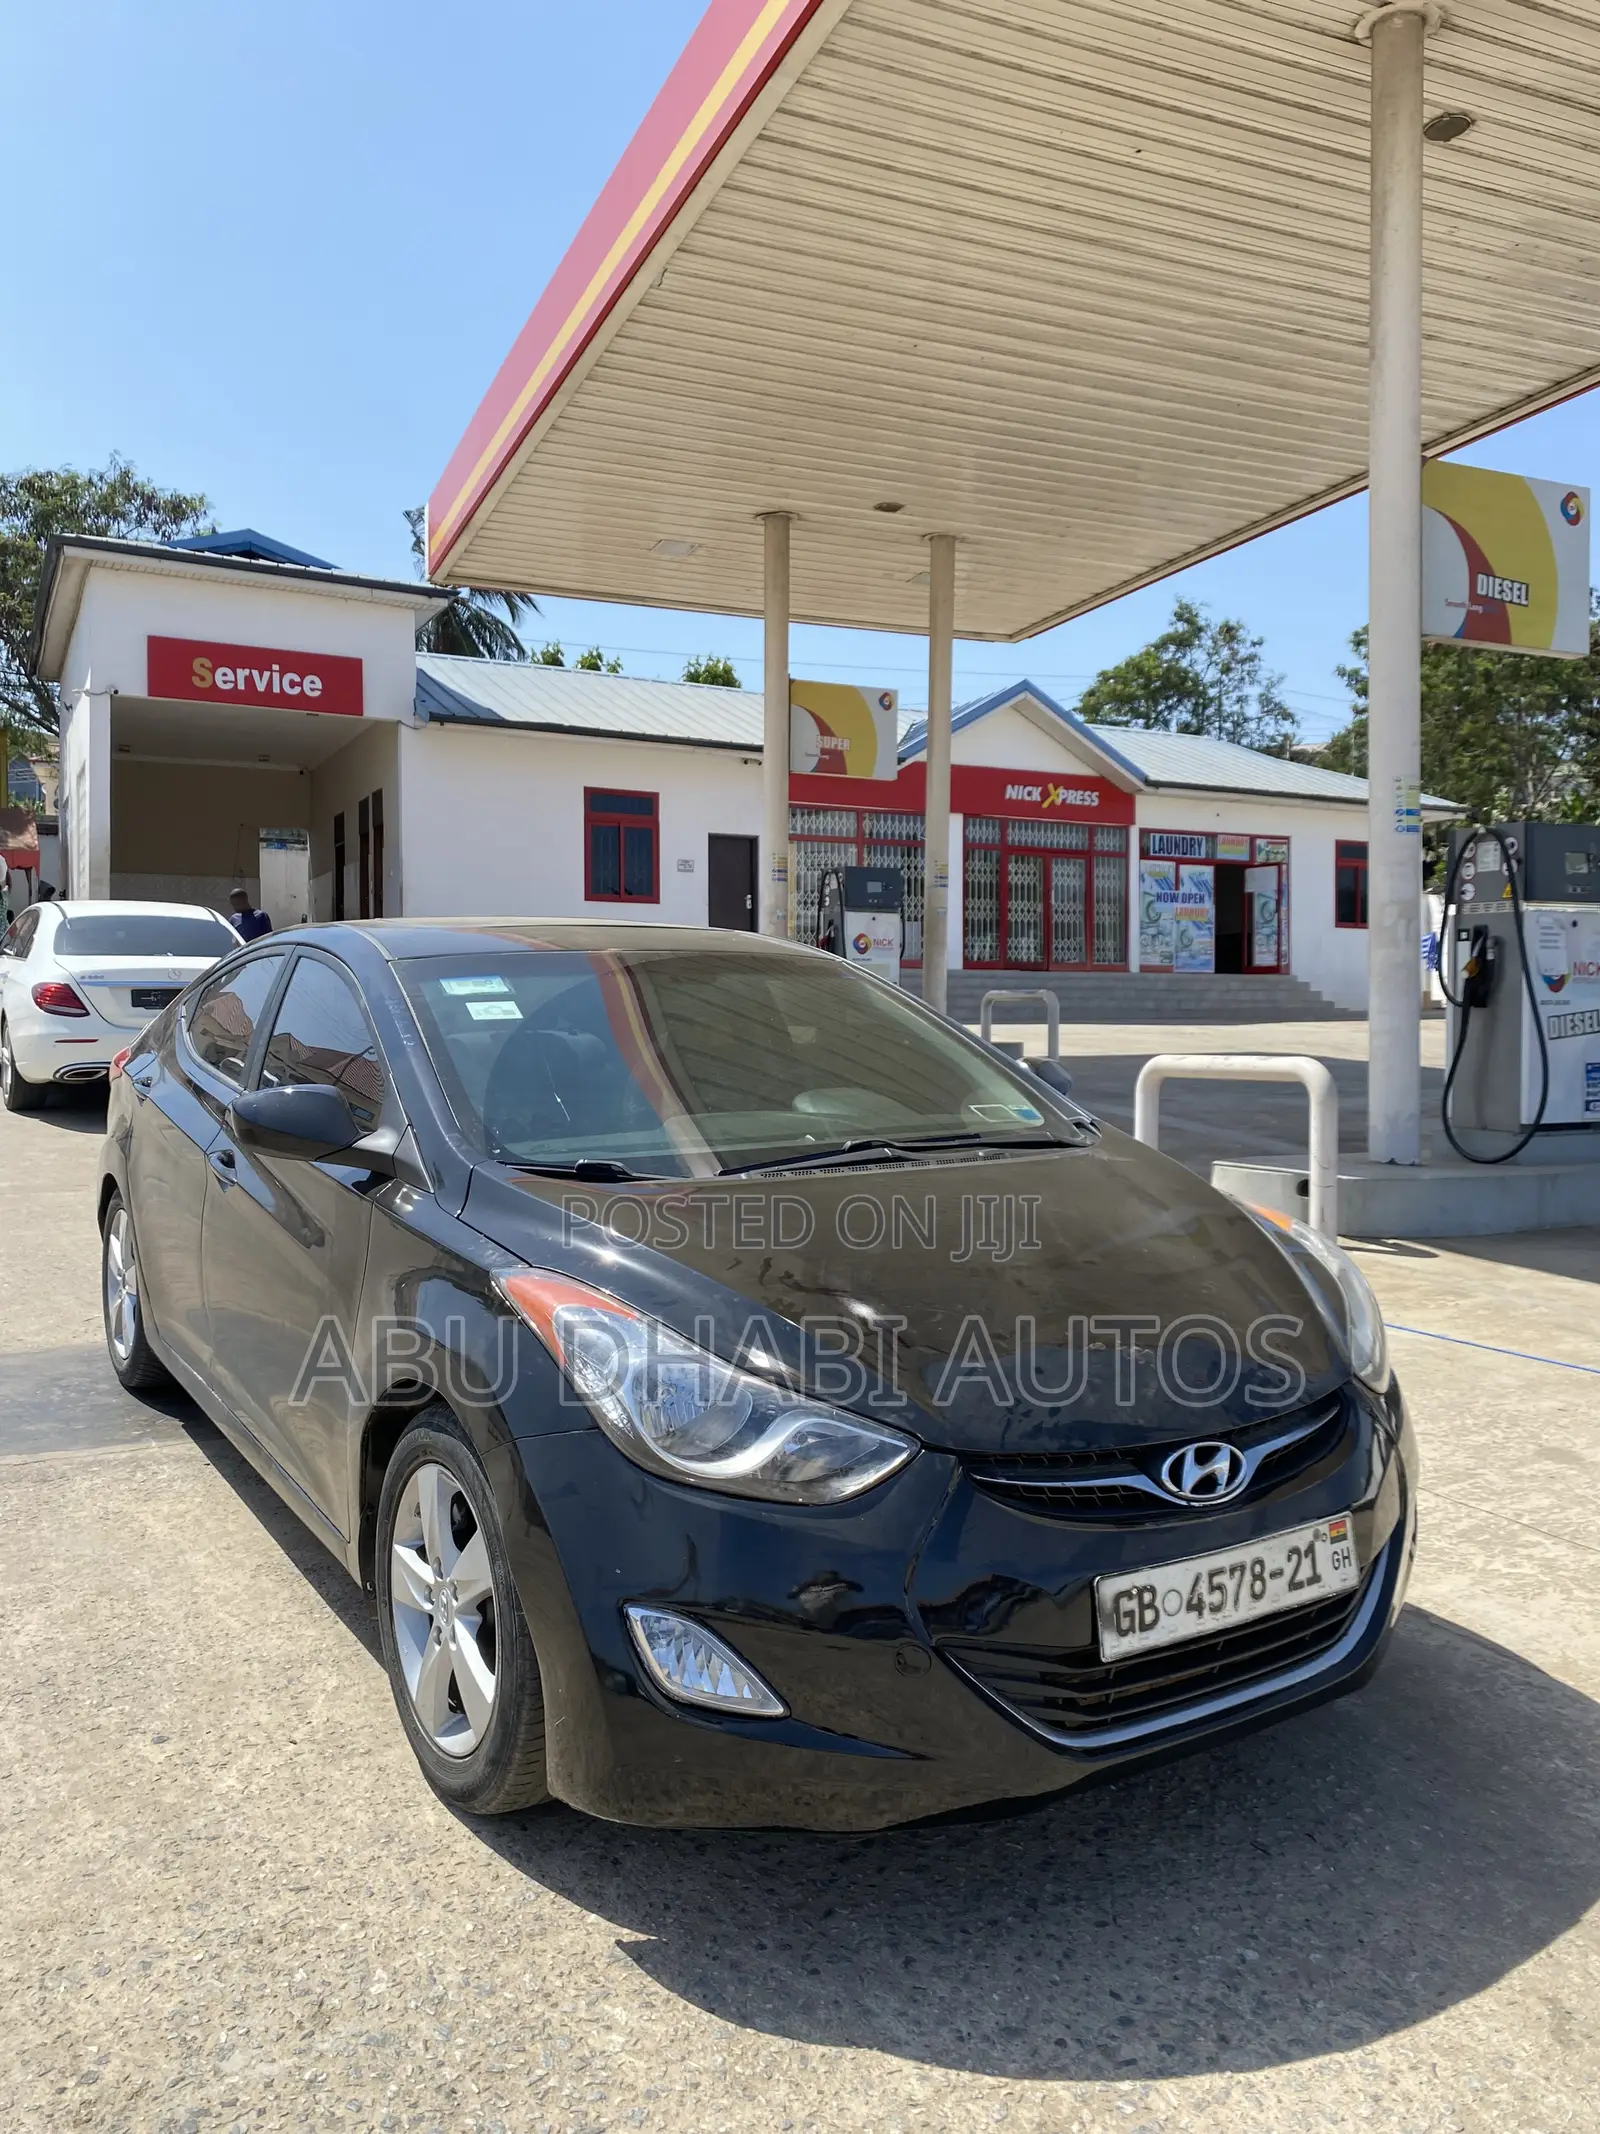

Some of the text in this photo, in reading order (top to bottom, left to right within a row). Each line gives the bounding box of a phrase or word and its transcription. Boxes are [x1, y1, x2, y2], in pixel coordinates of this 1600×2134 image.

[1477, 573, 1529, 605] DIESEL
[192, 657, 323, 697] Service
[816, 735, 850, 751] SUPER
[1005, 783, 1100, 808] NICK XPRESS
[1152, 834, 1204, 857] LAUNDRY
[1156, 891, 1205, 905] NOW OPEN
[873, 938, 894, 947] NICK
[1549, 1010, 1600, 1038] DIESEL
[1331, 1545, 1353, 1572] GH
[1113, 1540, 1322, 1638] GB 4578-21
